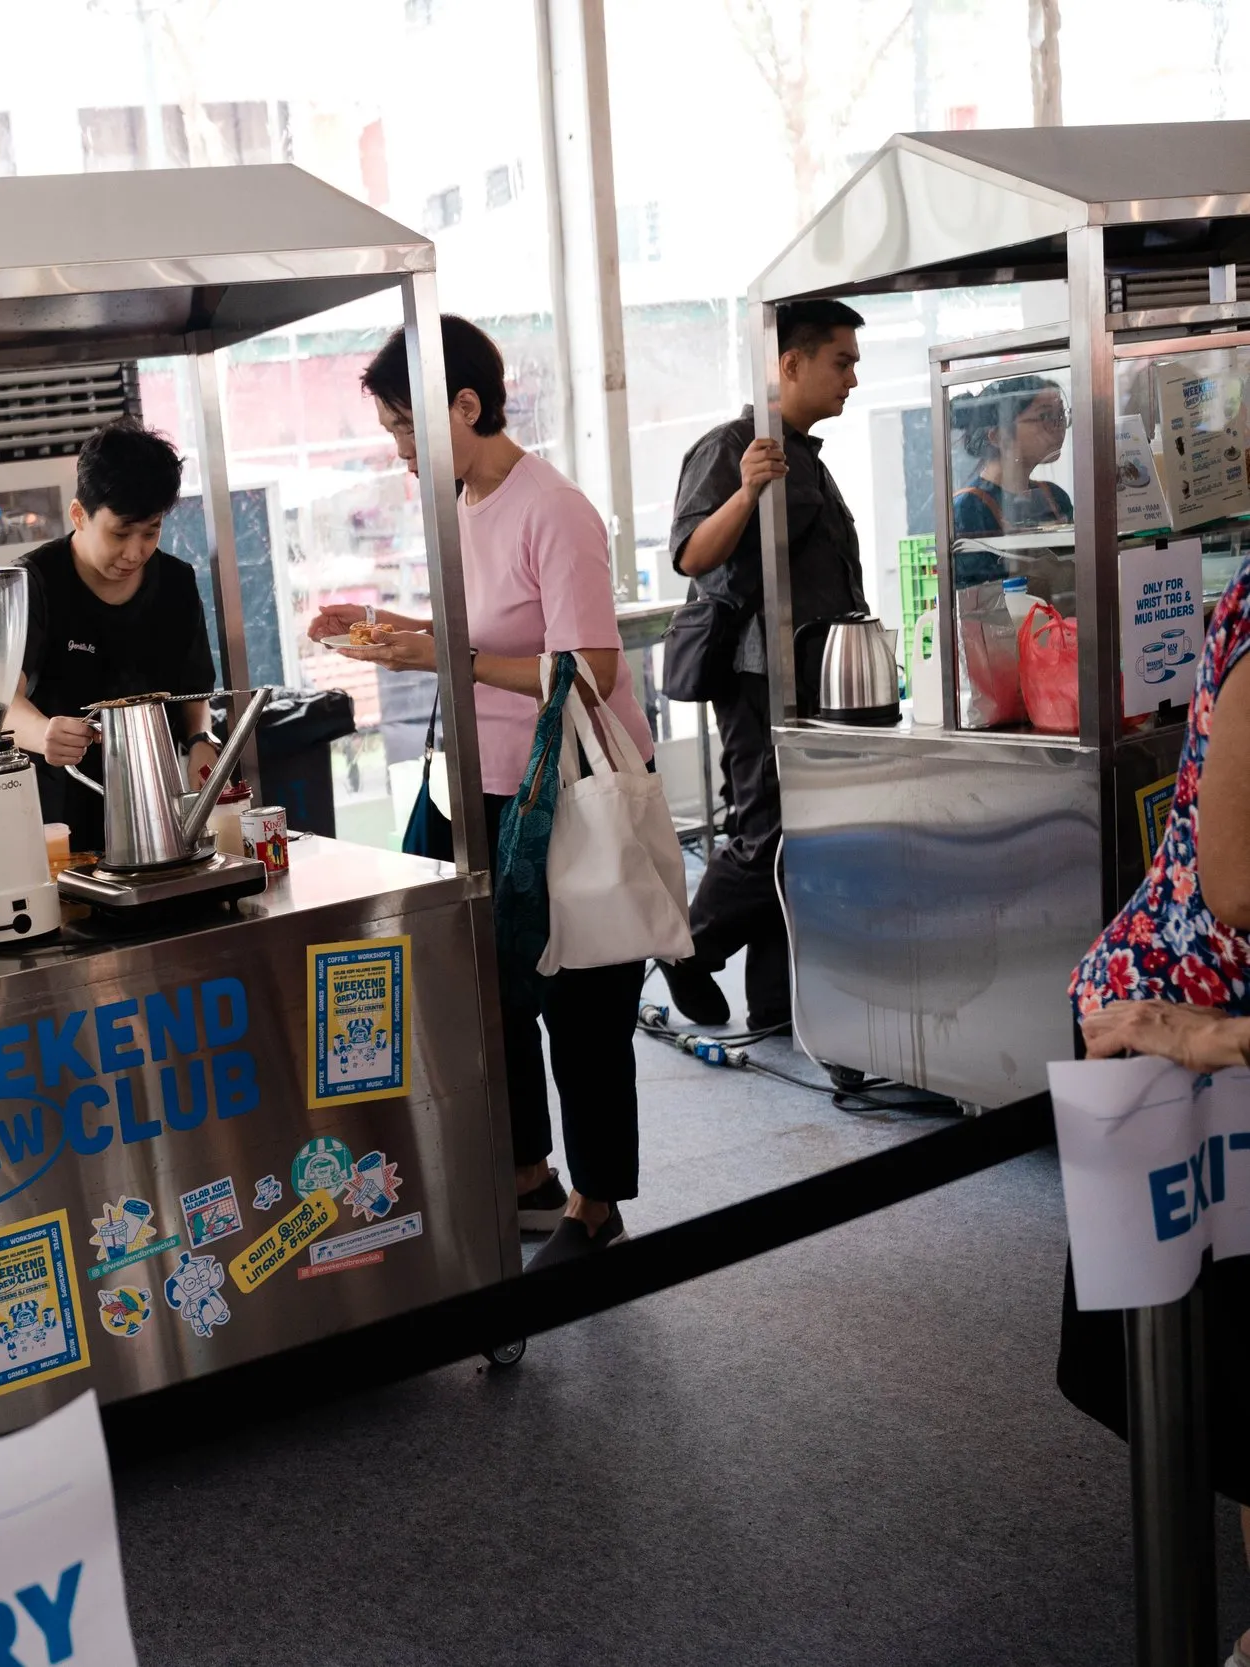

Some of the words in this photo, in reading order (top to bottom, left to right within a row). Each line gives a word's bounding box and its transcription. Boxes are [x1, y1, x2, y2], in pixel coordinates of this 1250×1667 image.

[1143, 581, 1162, 596] ONLY
[1166, 578, 1184, 590] FOR
[1136, 596, 1162, 611] WRIST
[1164, 593, 1182, 606] TAG
[1184, 591, 1191, 601] &
[1135, 612, 1153, 625] MUG
[1155, 604, 1194, 621] HOLDERS
[328, 956, 348, 964] COFFEE
[358, 951, 390, 960] WORKSHOPS
[334, 977, 386, 992] WEEKEND
[337, 992, 357, 1003] BREW
[358, 988, 386, 1000] CLUB
[366, 1080, 384, 1088] MUSIC
[65, 1050, 260, 1156] CLUB
[183, 1188, 210, 1205] KELAB
[212, 1180, 230, 1193] KOPI
[185, 1198, 208, 1212] HUJUNG
[209, 1188, 232, 1201] MINGGU
[10, 1229, 47, 1245] WORKSHOPS
[102, 1238, 176, 1273] @weekendbrewclub
[249, 1237, 276, 1264] வார
[51, 1227, 60, 1251] COFFEE
[56, 1260, 68, 1298] WORKSHOPS
[18, 1267, 48, 1284] CLUB
[7, 1368, 28, 1379] GAMES
[40, 1358, 59, 1368] MUSIC
